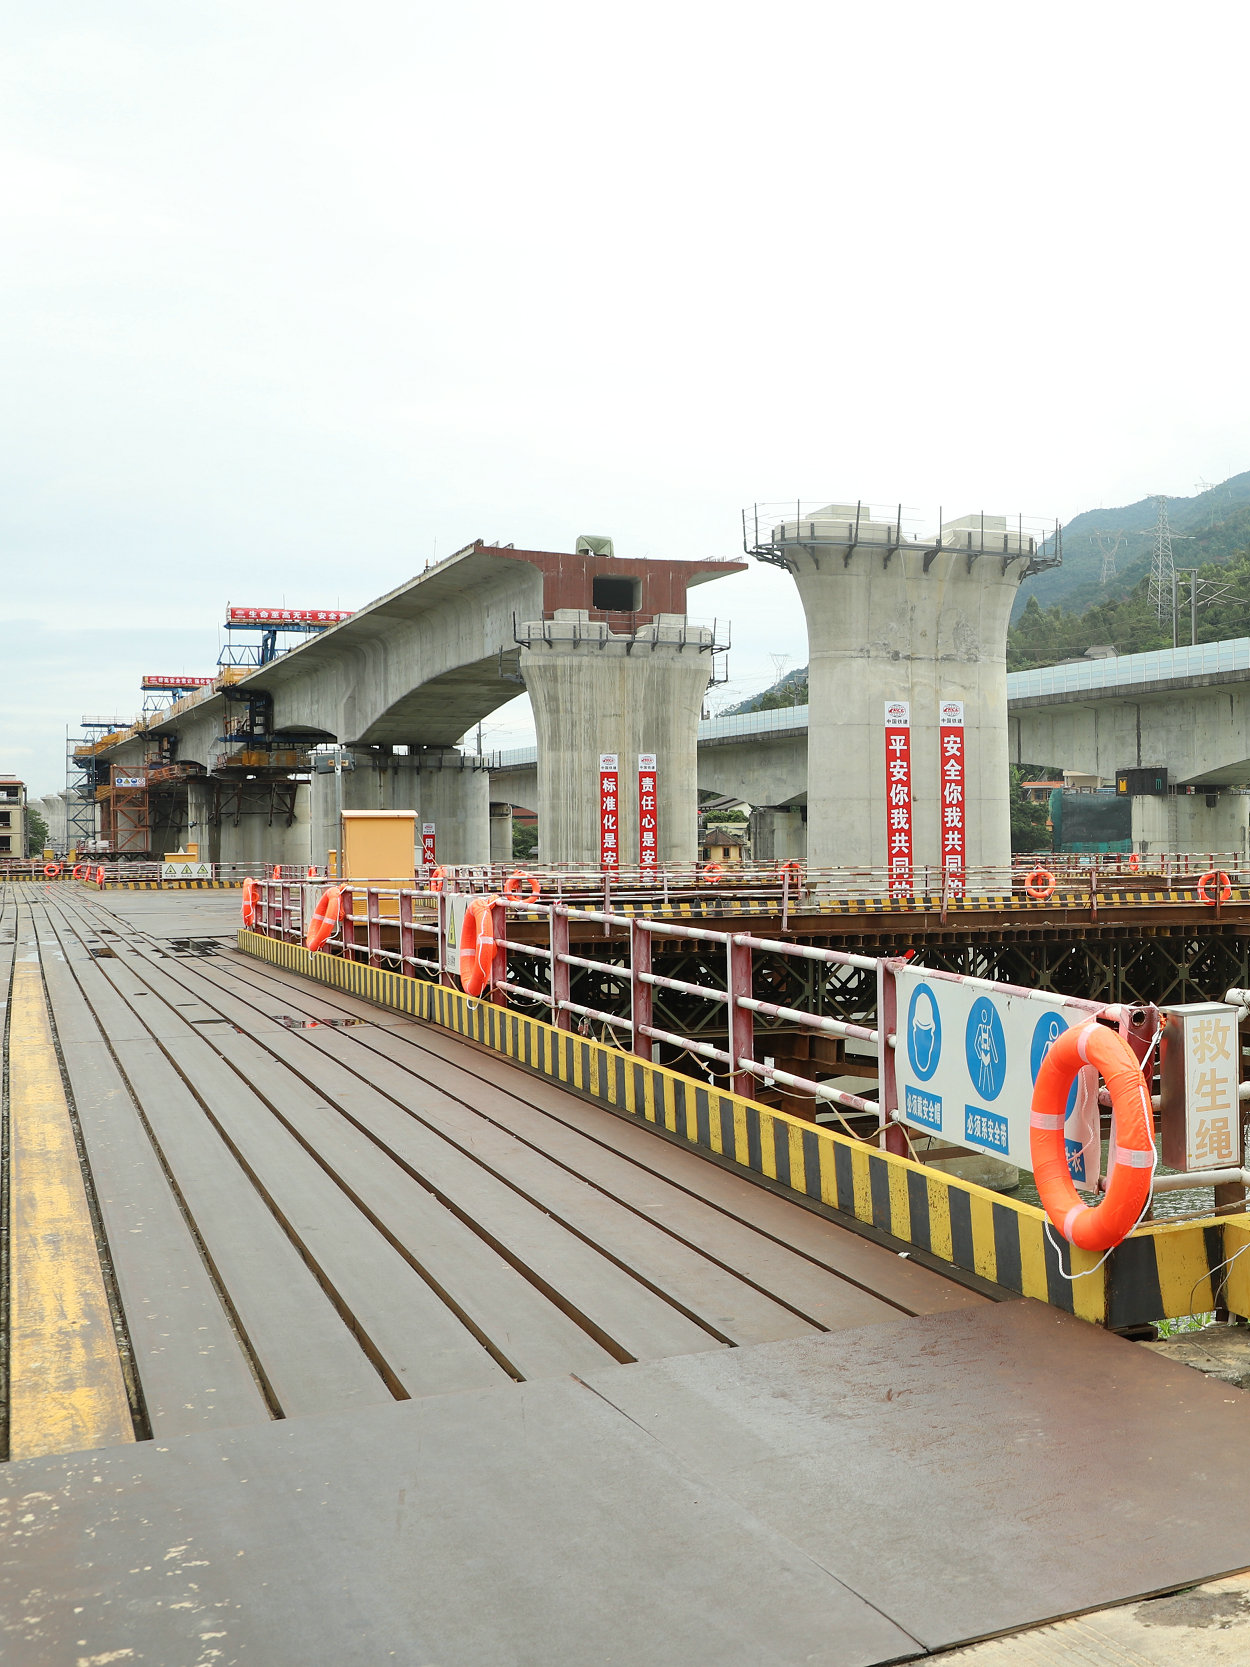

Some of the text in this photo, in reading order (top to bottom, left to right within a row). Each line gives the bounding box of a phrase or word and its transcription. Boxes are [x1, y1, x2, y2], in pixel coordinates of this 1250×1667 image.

[248, 610, 312, 619] 生命至高无上
[602, 777, 617, 882] 标准化是安
[1191, 1017, 1233, 1161] 救生绳
[906, 1091, 942, 1126] 必须戴安全帽
[966, 1112, 1008, 1149] 必须系安全带
